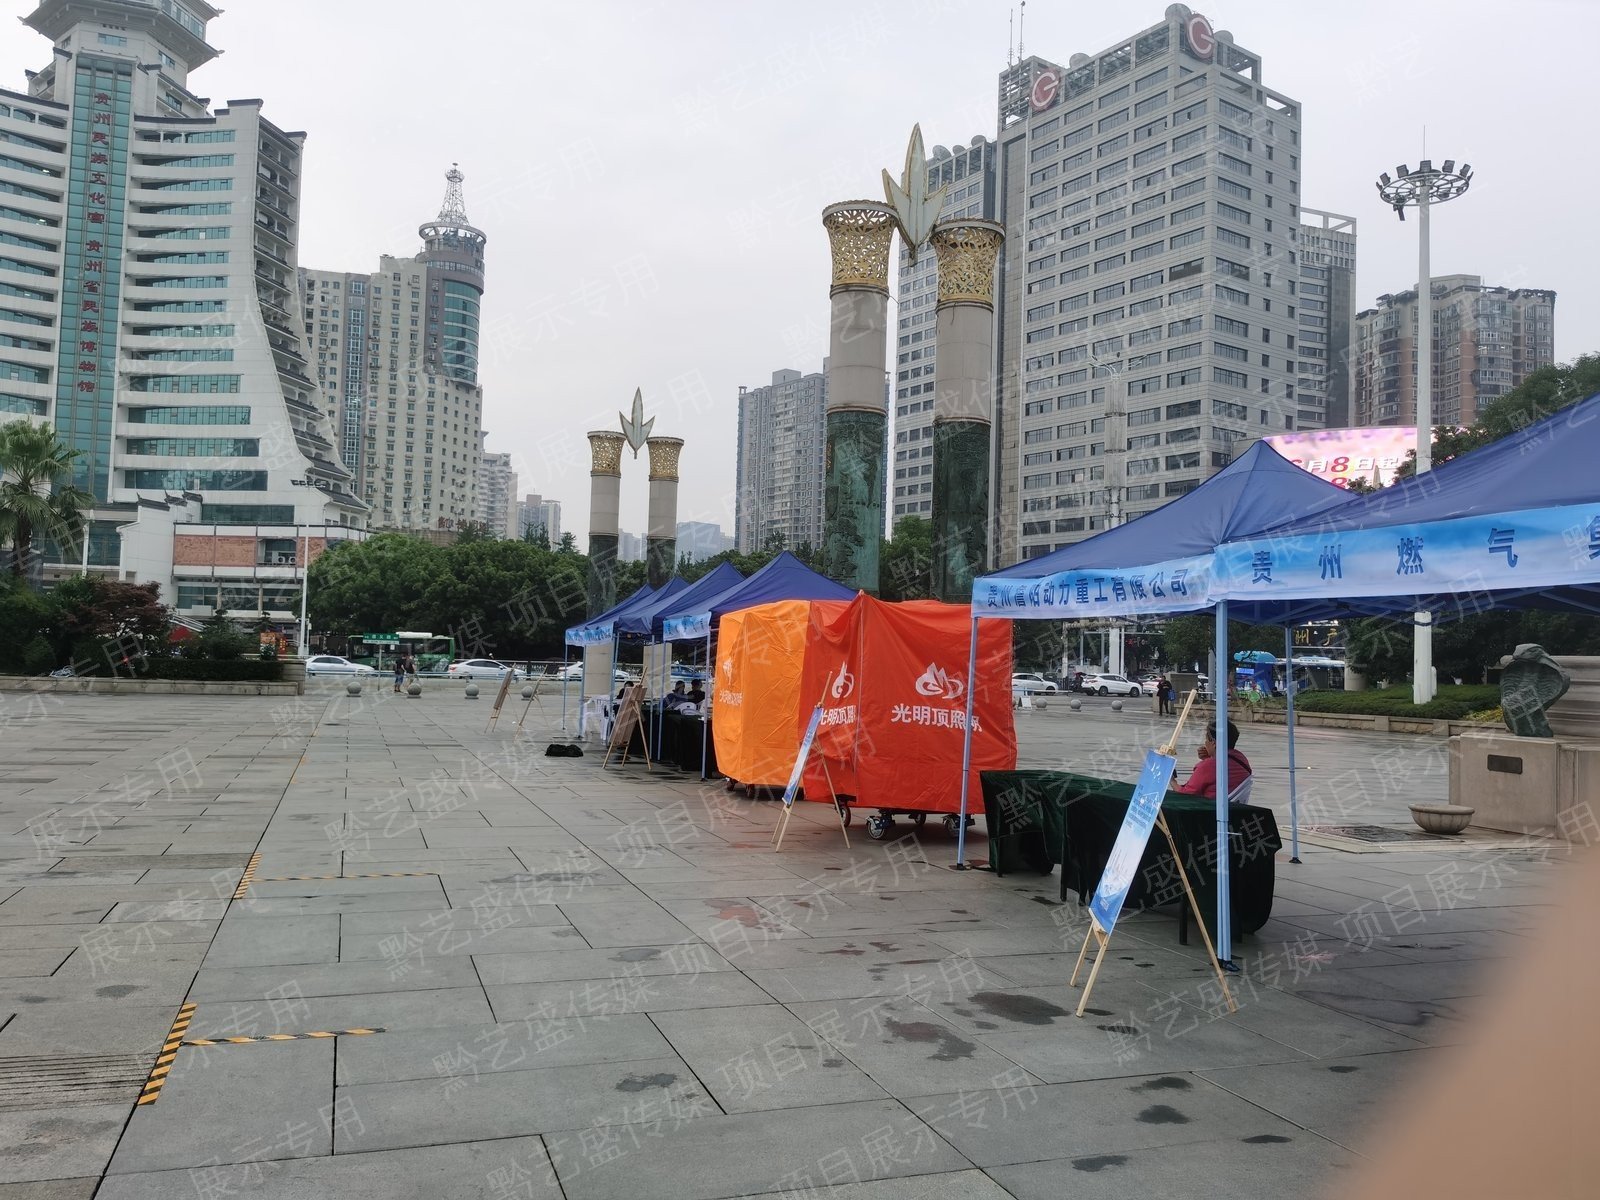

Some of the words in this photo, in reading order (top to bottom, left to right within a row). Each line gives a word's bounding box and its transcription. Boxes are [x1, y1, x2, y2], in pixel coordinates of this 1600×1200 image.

[87, 92, 111, 224] 贵州民族文化宫
[78, 240, 103, 392] 贵州省民族博物馆
